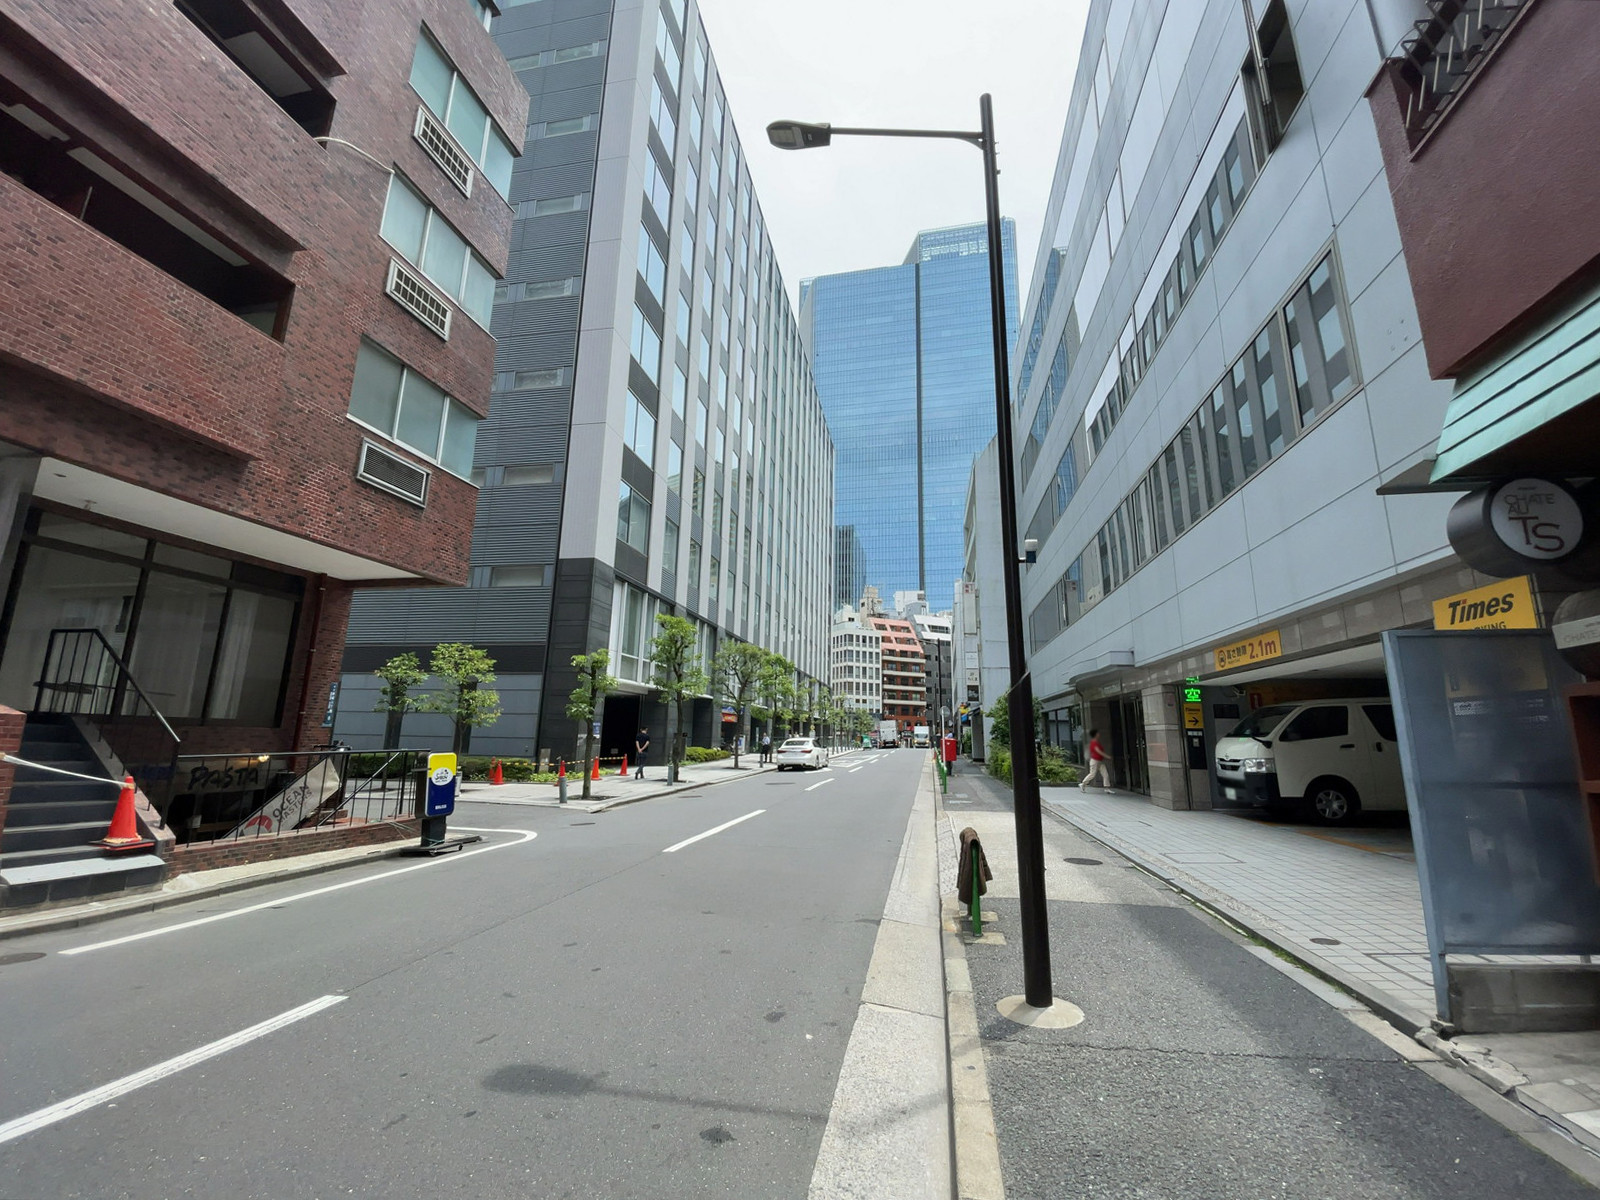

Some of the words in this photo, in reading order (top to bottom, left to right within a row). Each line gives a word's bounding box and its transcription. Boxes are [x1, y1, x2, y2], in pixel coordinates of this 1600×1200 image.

[1508, 516, 1565, 552] TS
[1448, 593, 1514, 625] Times
[1248, 639, 1277, 660] 2.1m
[1184, 687, 1202, 702] 空
[188, 766, 259, 791] PASTA
[272, 785, 309, 818] OCEAN
